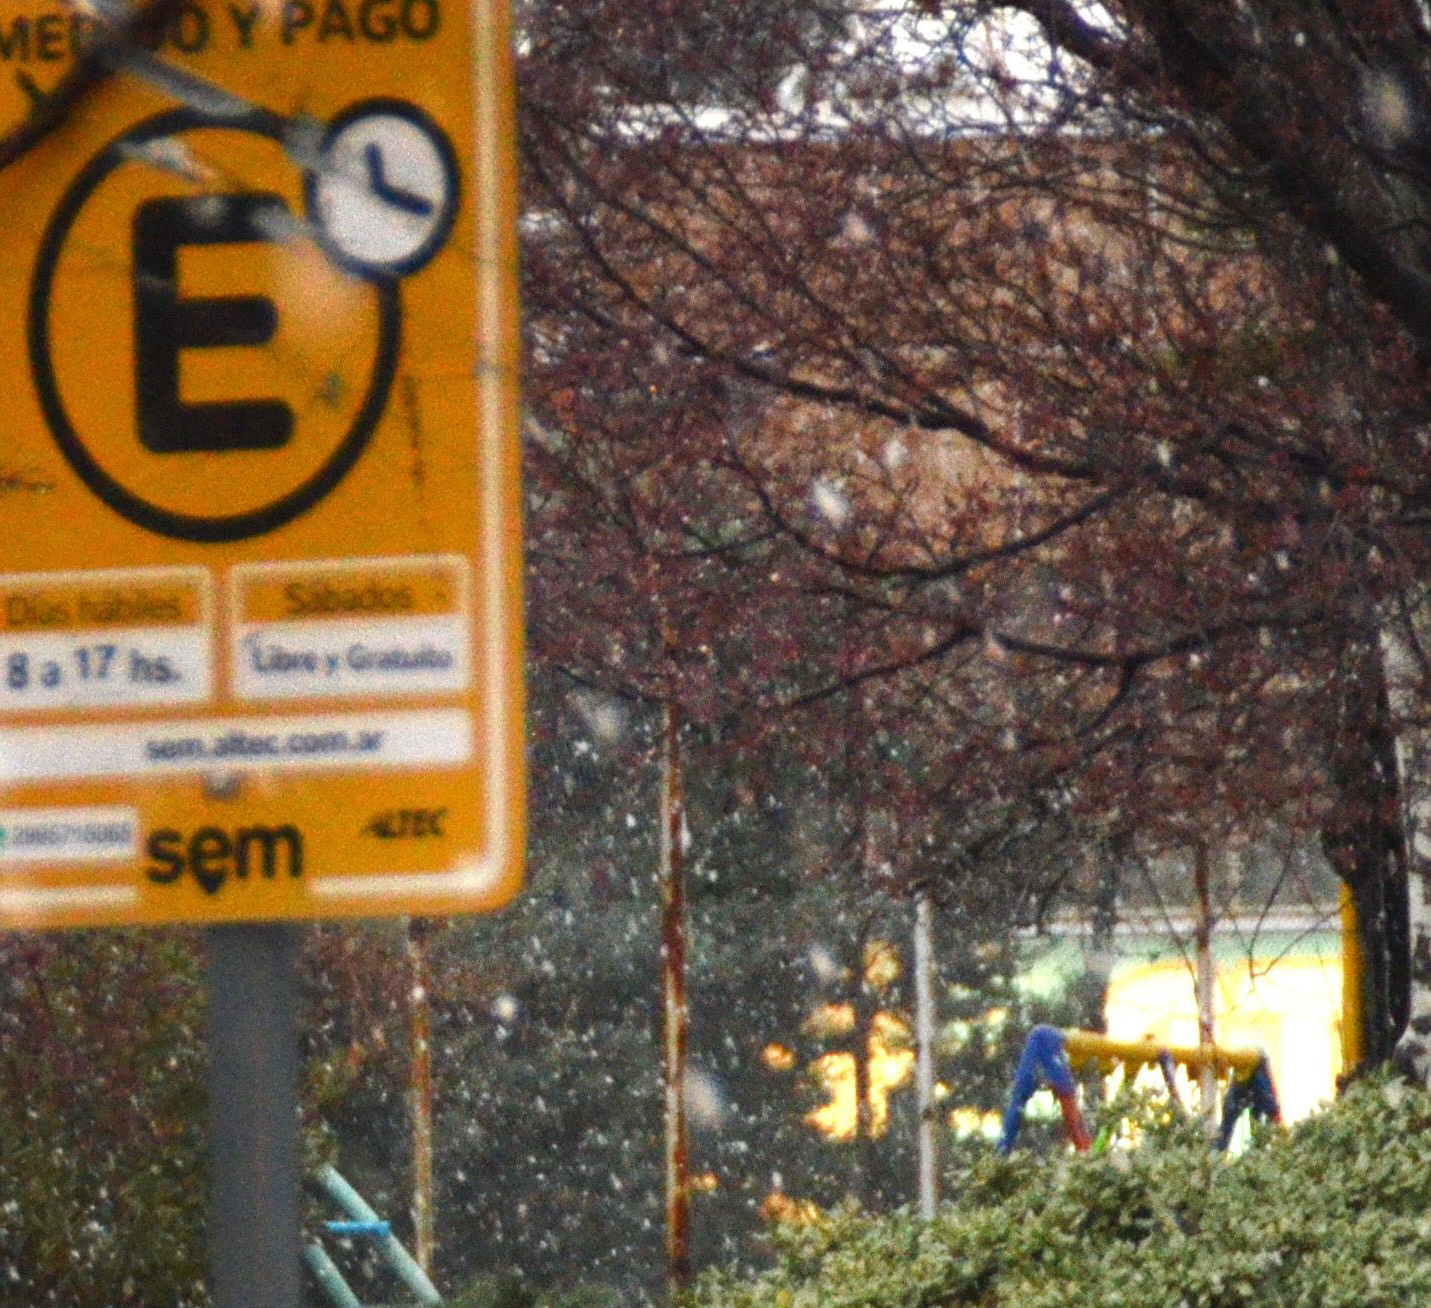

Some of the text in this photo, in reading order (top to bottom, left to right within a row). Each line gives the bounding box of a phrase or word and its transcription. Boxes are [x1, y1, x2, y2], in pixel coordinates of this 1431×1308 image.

[228, 0, 257, 48] Y
[282, 0, 441, 46] PAGO
[133, 190, 295, 454] E
[7, 651, 29, 690] 8
[41, 660, 61, 689] a
[75, 643, 117, 679] 17
[251, 643, 454, 676] Libre y Gratuito
[146, 731, 384, 762] sem.altec.com.ar
[146, 824, 304, 894] sem
